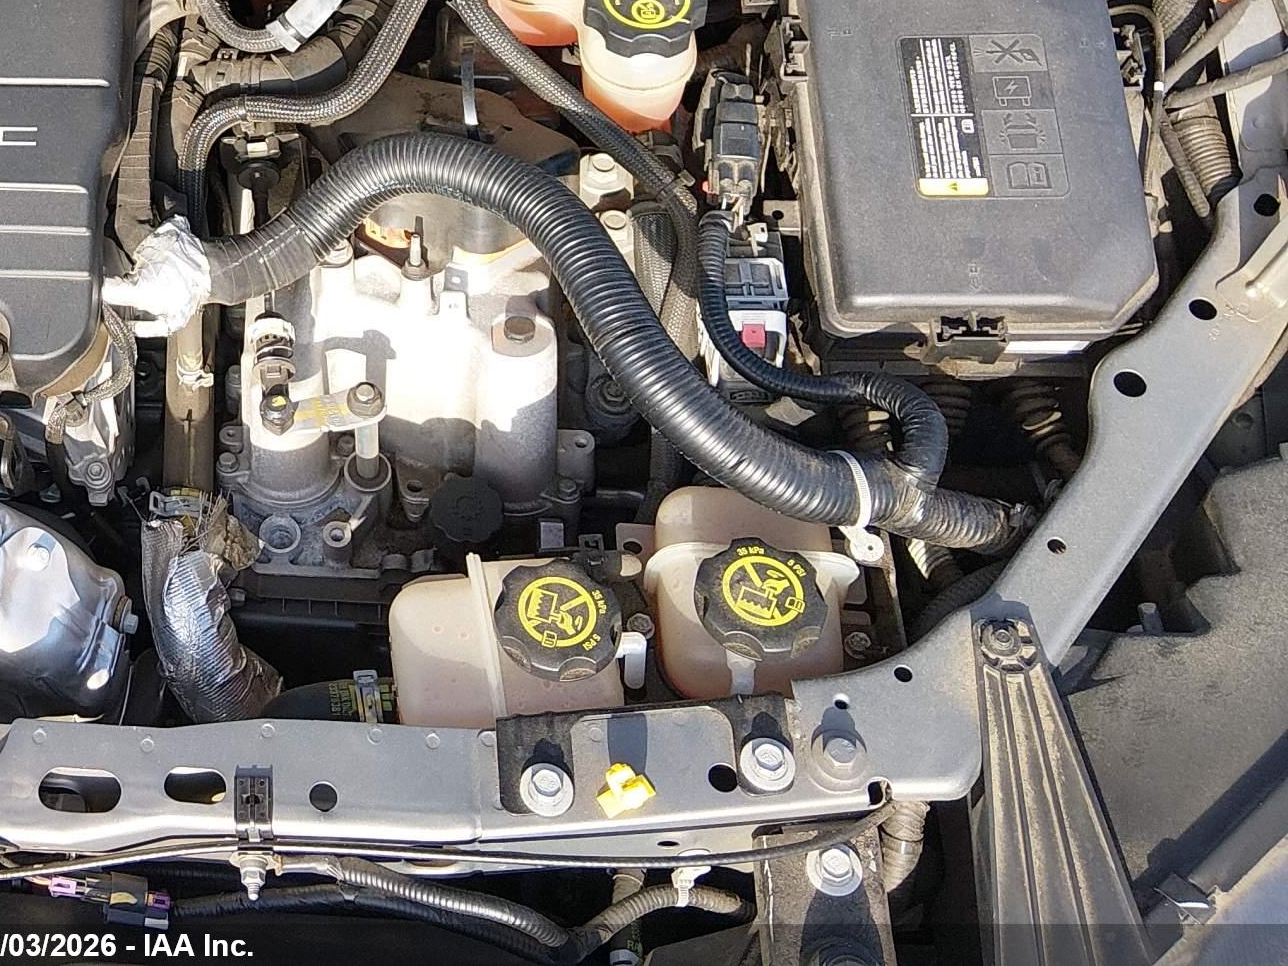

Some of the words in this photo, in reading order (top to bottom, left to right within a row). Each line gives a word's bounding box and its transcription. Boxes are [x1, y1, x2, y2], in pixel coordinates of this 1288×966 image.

[736, 546, 748, 556] 35
[748, 546, 765, 555] kPa
[792, 563, 807, 578] PSI
[592, 589, 602, 603] 35
[596, 599, 607, 615] kPa
[582, 638, 597, 651] PSI
